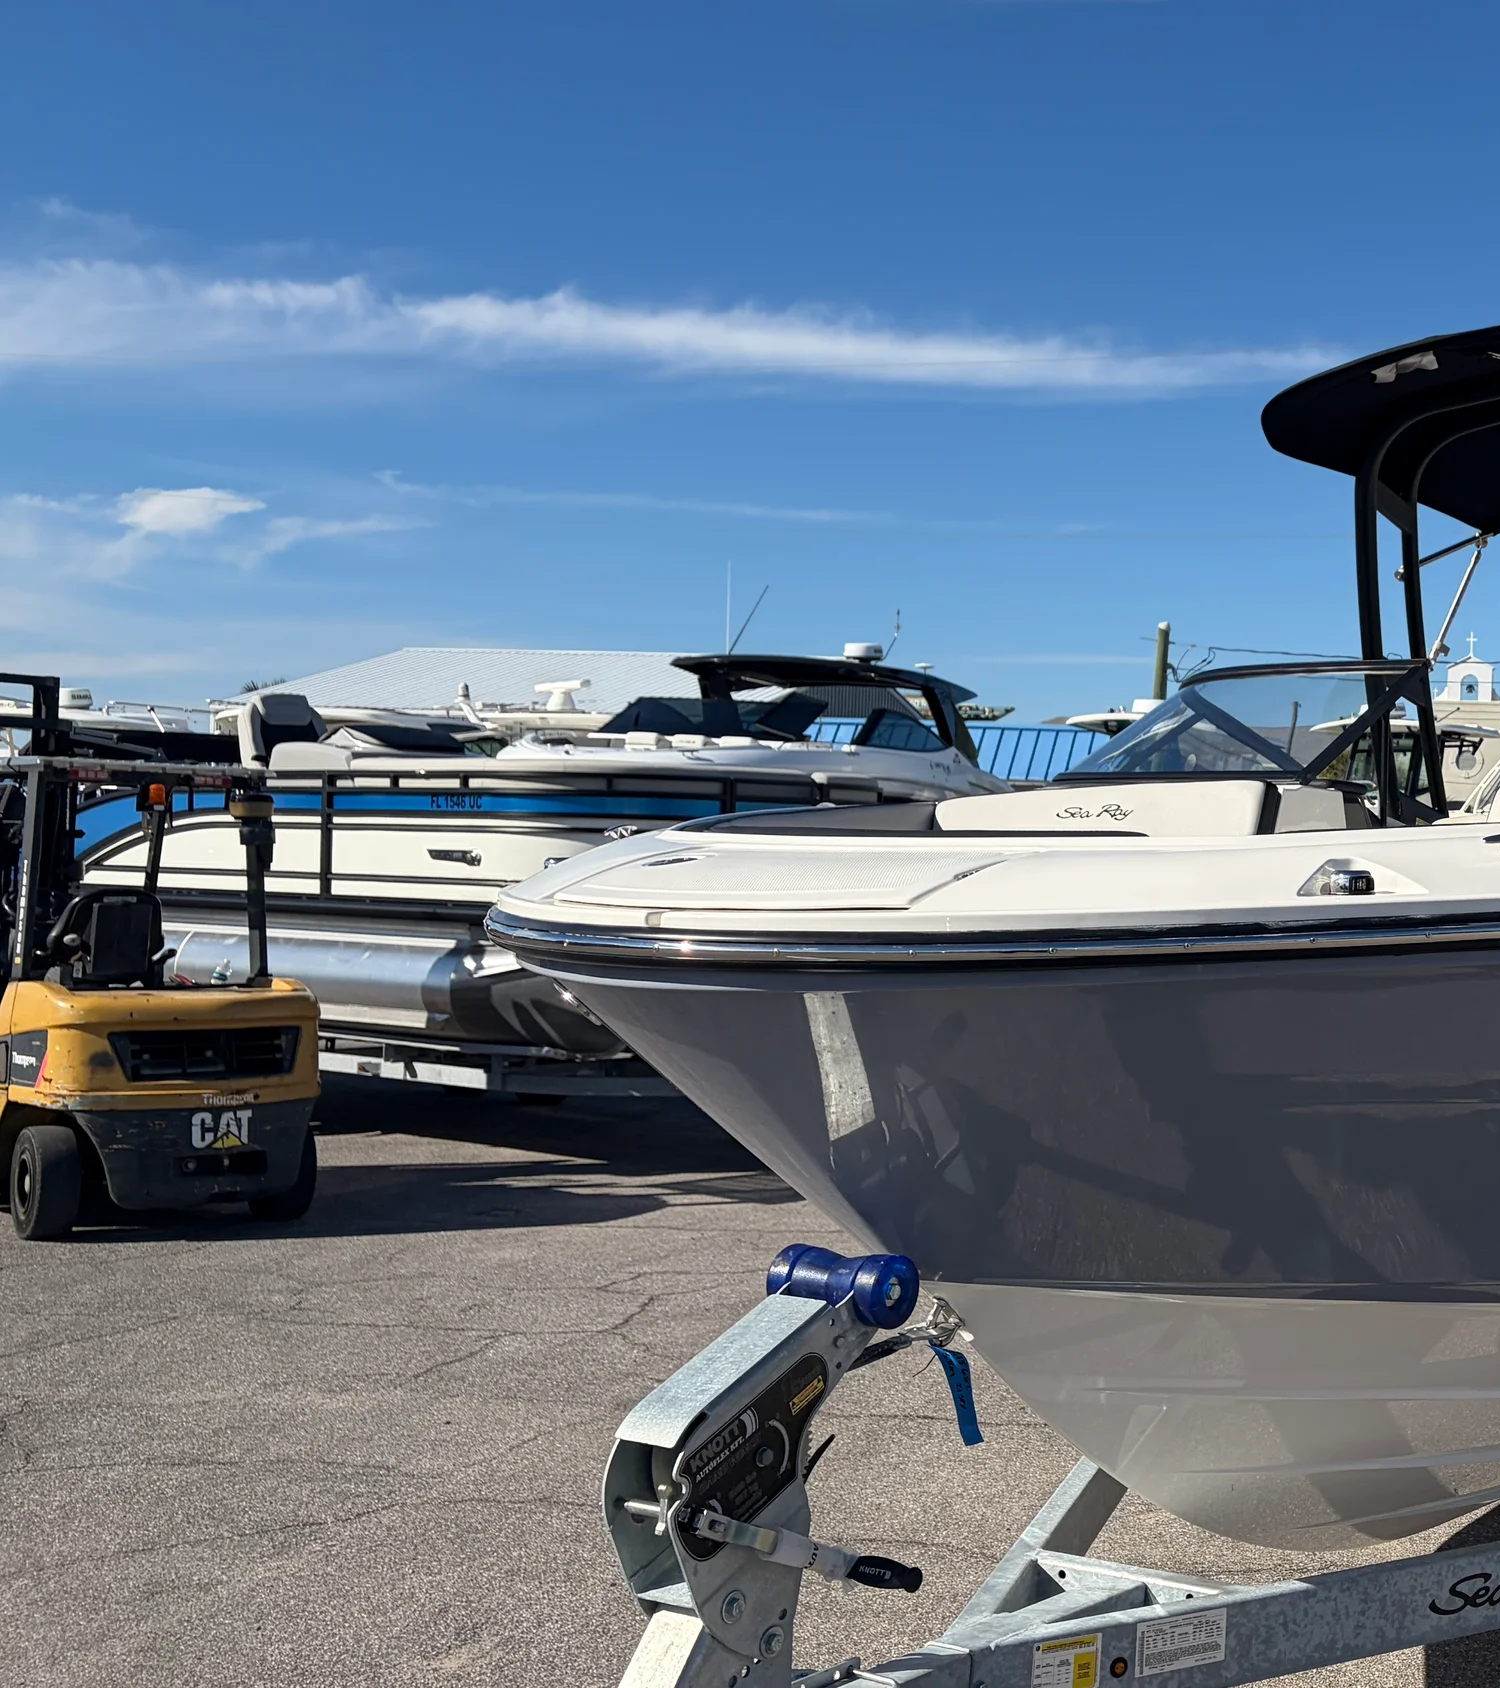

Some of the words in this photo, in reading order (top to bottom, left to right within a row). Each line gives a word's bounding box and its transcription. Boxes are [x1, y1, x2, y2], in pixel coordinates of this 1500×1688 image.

[430, 795, 441, 808] FL
[445, 795, 466, 808] 1546
[469, 795, 482, 809] UC
[1056, 806, 1094, 819] Sea
[1096, 803, 1134, 821] Ray
[191, 1109, 253, 1149] CAT
[690, 1419, 740, 1473] KNOTT
[859, 1565, 885, 1578] KNOTT
